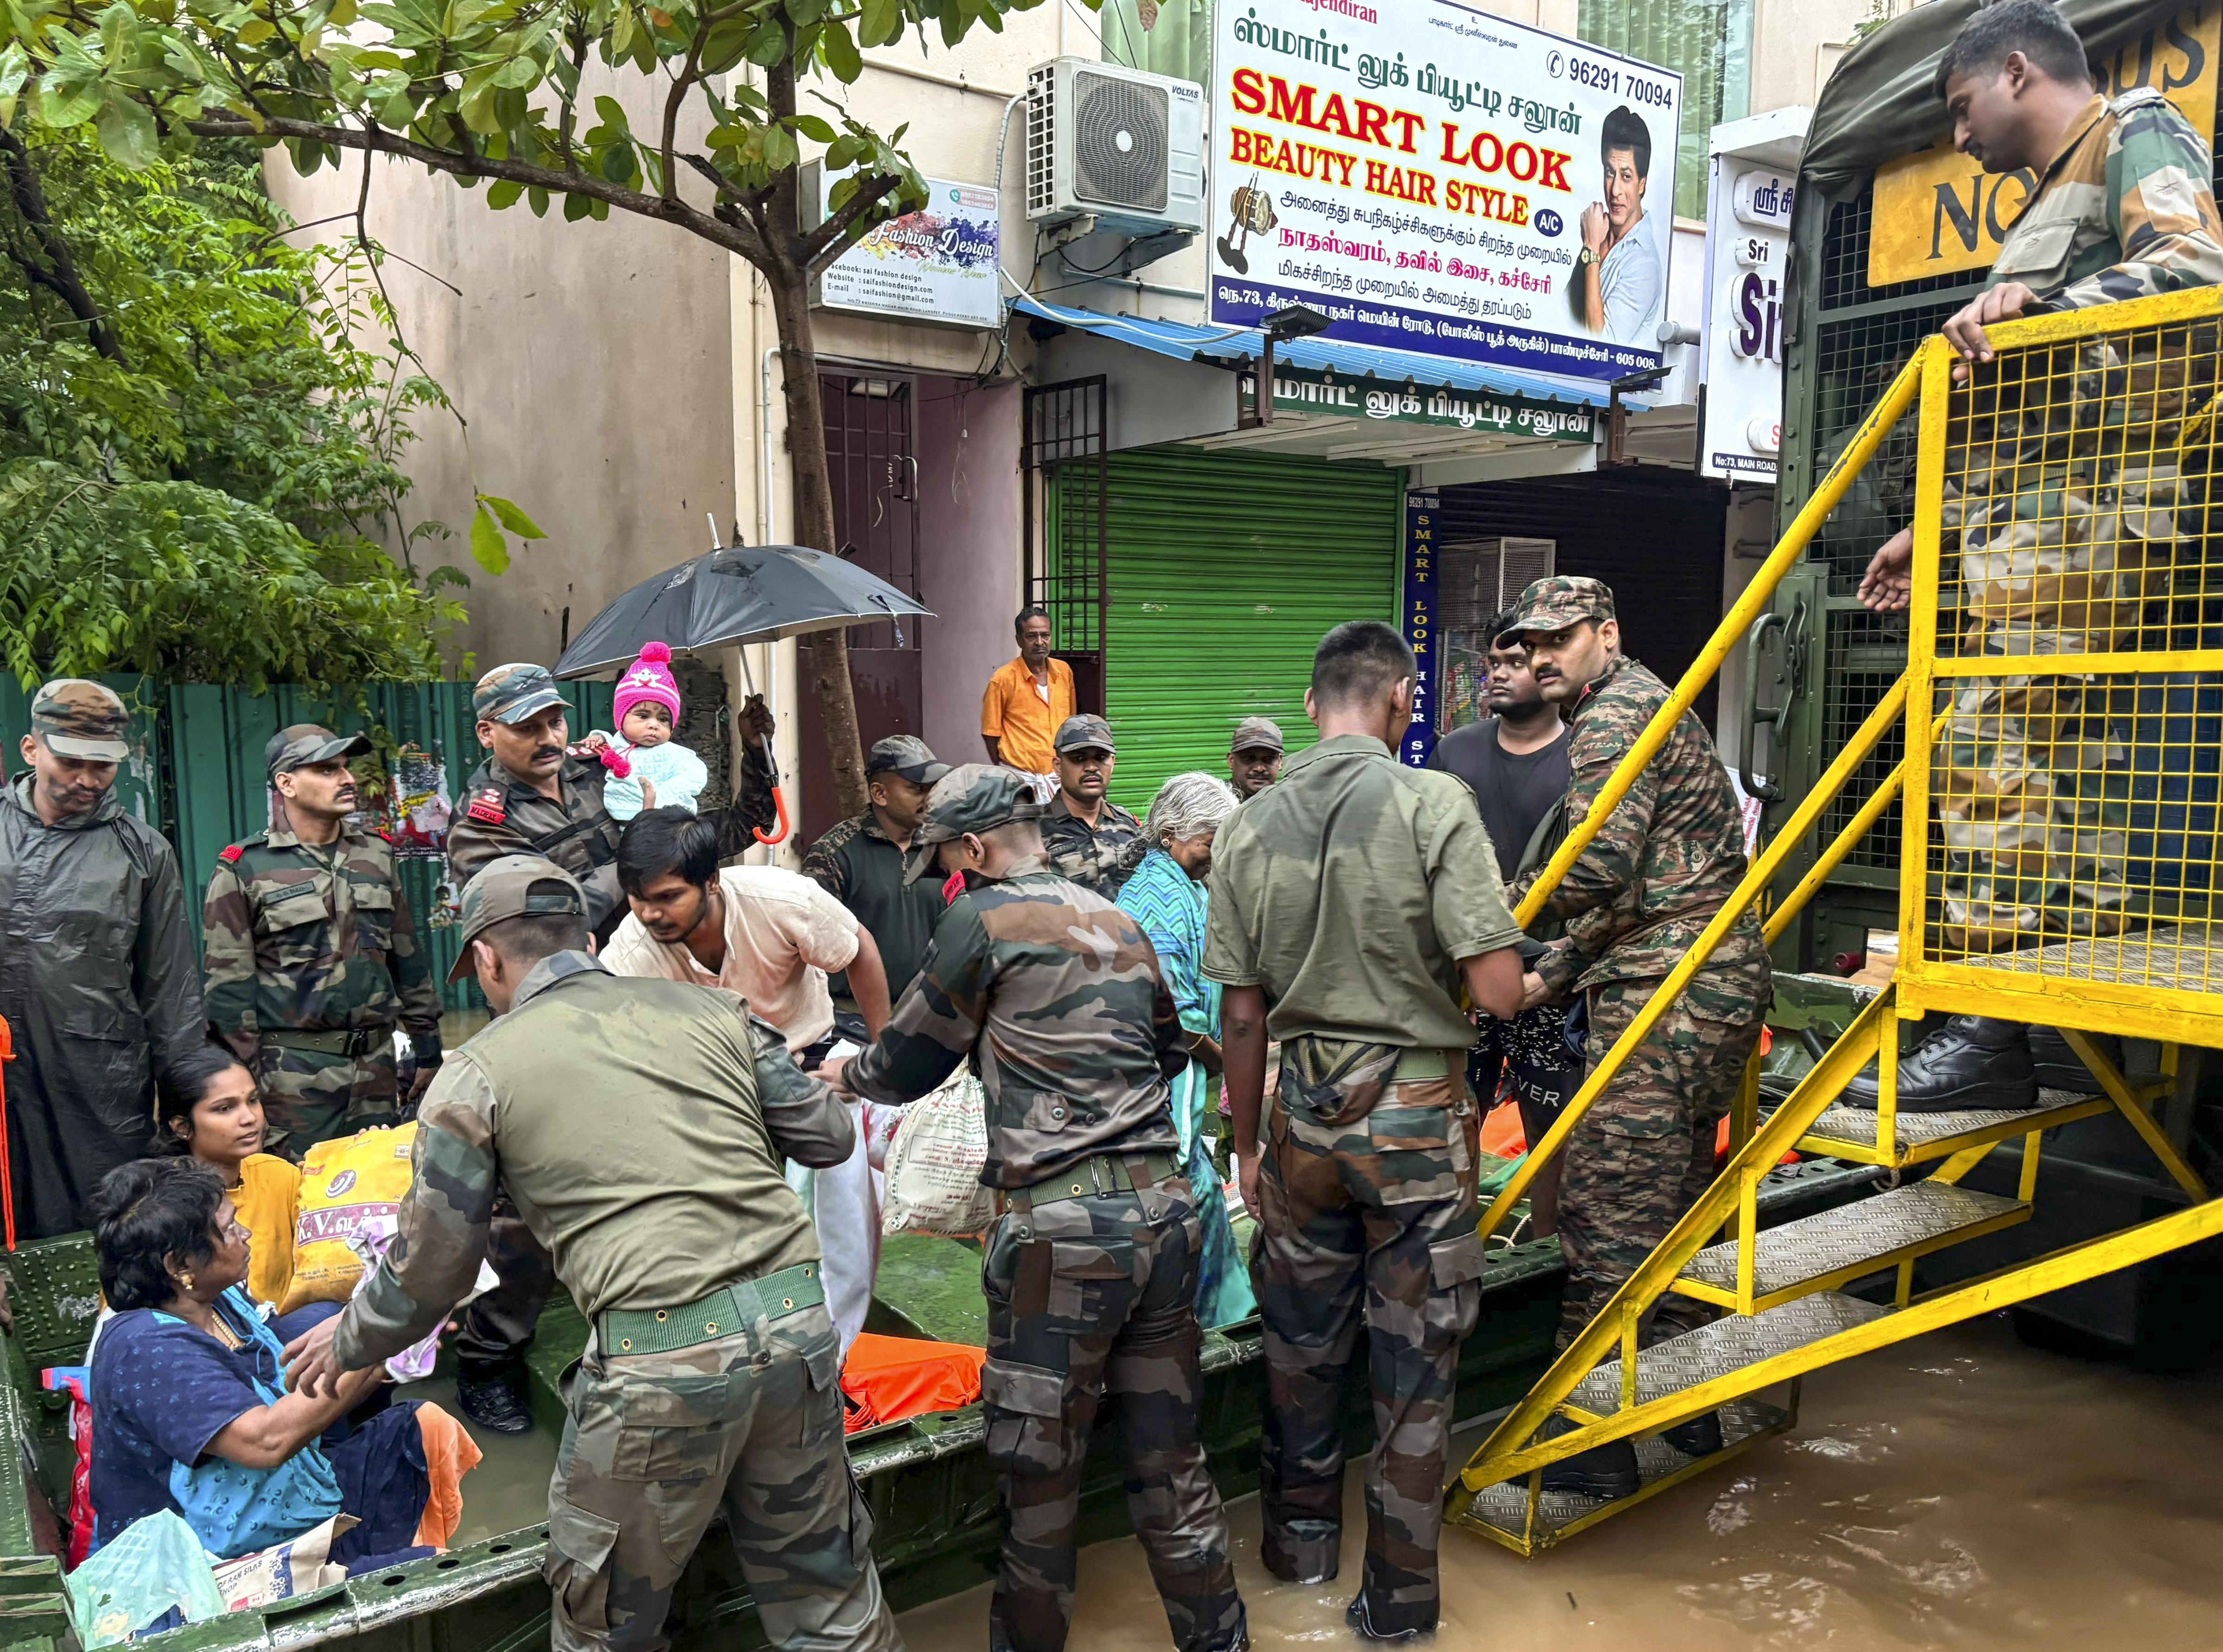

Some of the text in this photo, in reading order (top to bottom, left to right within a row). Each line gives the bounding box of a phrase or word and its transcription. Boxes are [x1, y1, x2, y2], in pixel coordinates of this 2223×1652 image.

[1234, 7, 1350, 72] ஸ்மார்ட்
[1357, 51, 1409, 89] லுக்
[1172, 86, 1199, 99] VOLTAS
[1570, 57, 1672, 110] 96291 70094
[1231, 67, 1572, 194] SMART LOOK
[1230, 126, 1559, 232] BEAUTY HAIR STYLE A/C
[868, 219, 993, 259] Fashion Design
[1748, 239, 1768, 262] Sri
[827, 272, 854, 283] Website
[863, 278, 933, 294] saifashiondesign.com
[831, 264, 861, 273] acebook:
[874, 268, 898, 278] fashion
[900, 273, 922, 283] design
[828, 283, 849, 292] E-mail
[862, 288, 934, 304] saifashion@gmail.com
[1616, 352, 1635, 366] 605
[1365, 386, 1422, 419] லுக்
[1737, 459, 1755, 469] MAIN
[1414, 515, 1432, 583] SMART
[1413, 600, 1427, 653] LOOK
[1411, 671, 1426, 723] HAIR
[217, 1560, 263, 1589] OF RAM SILKS
